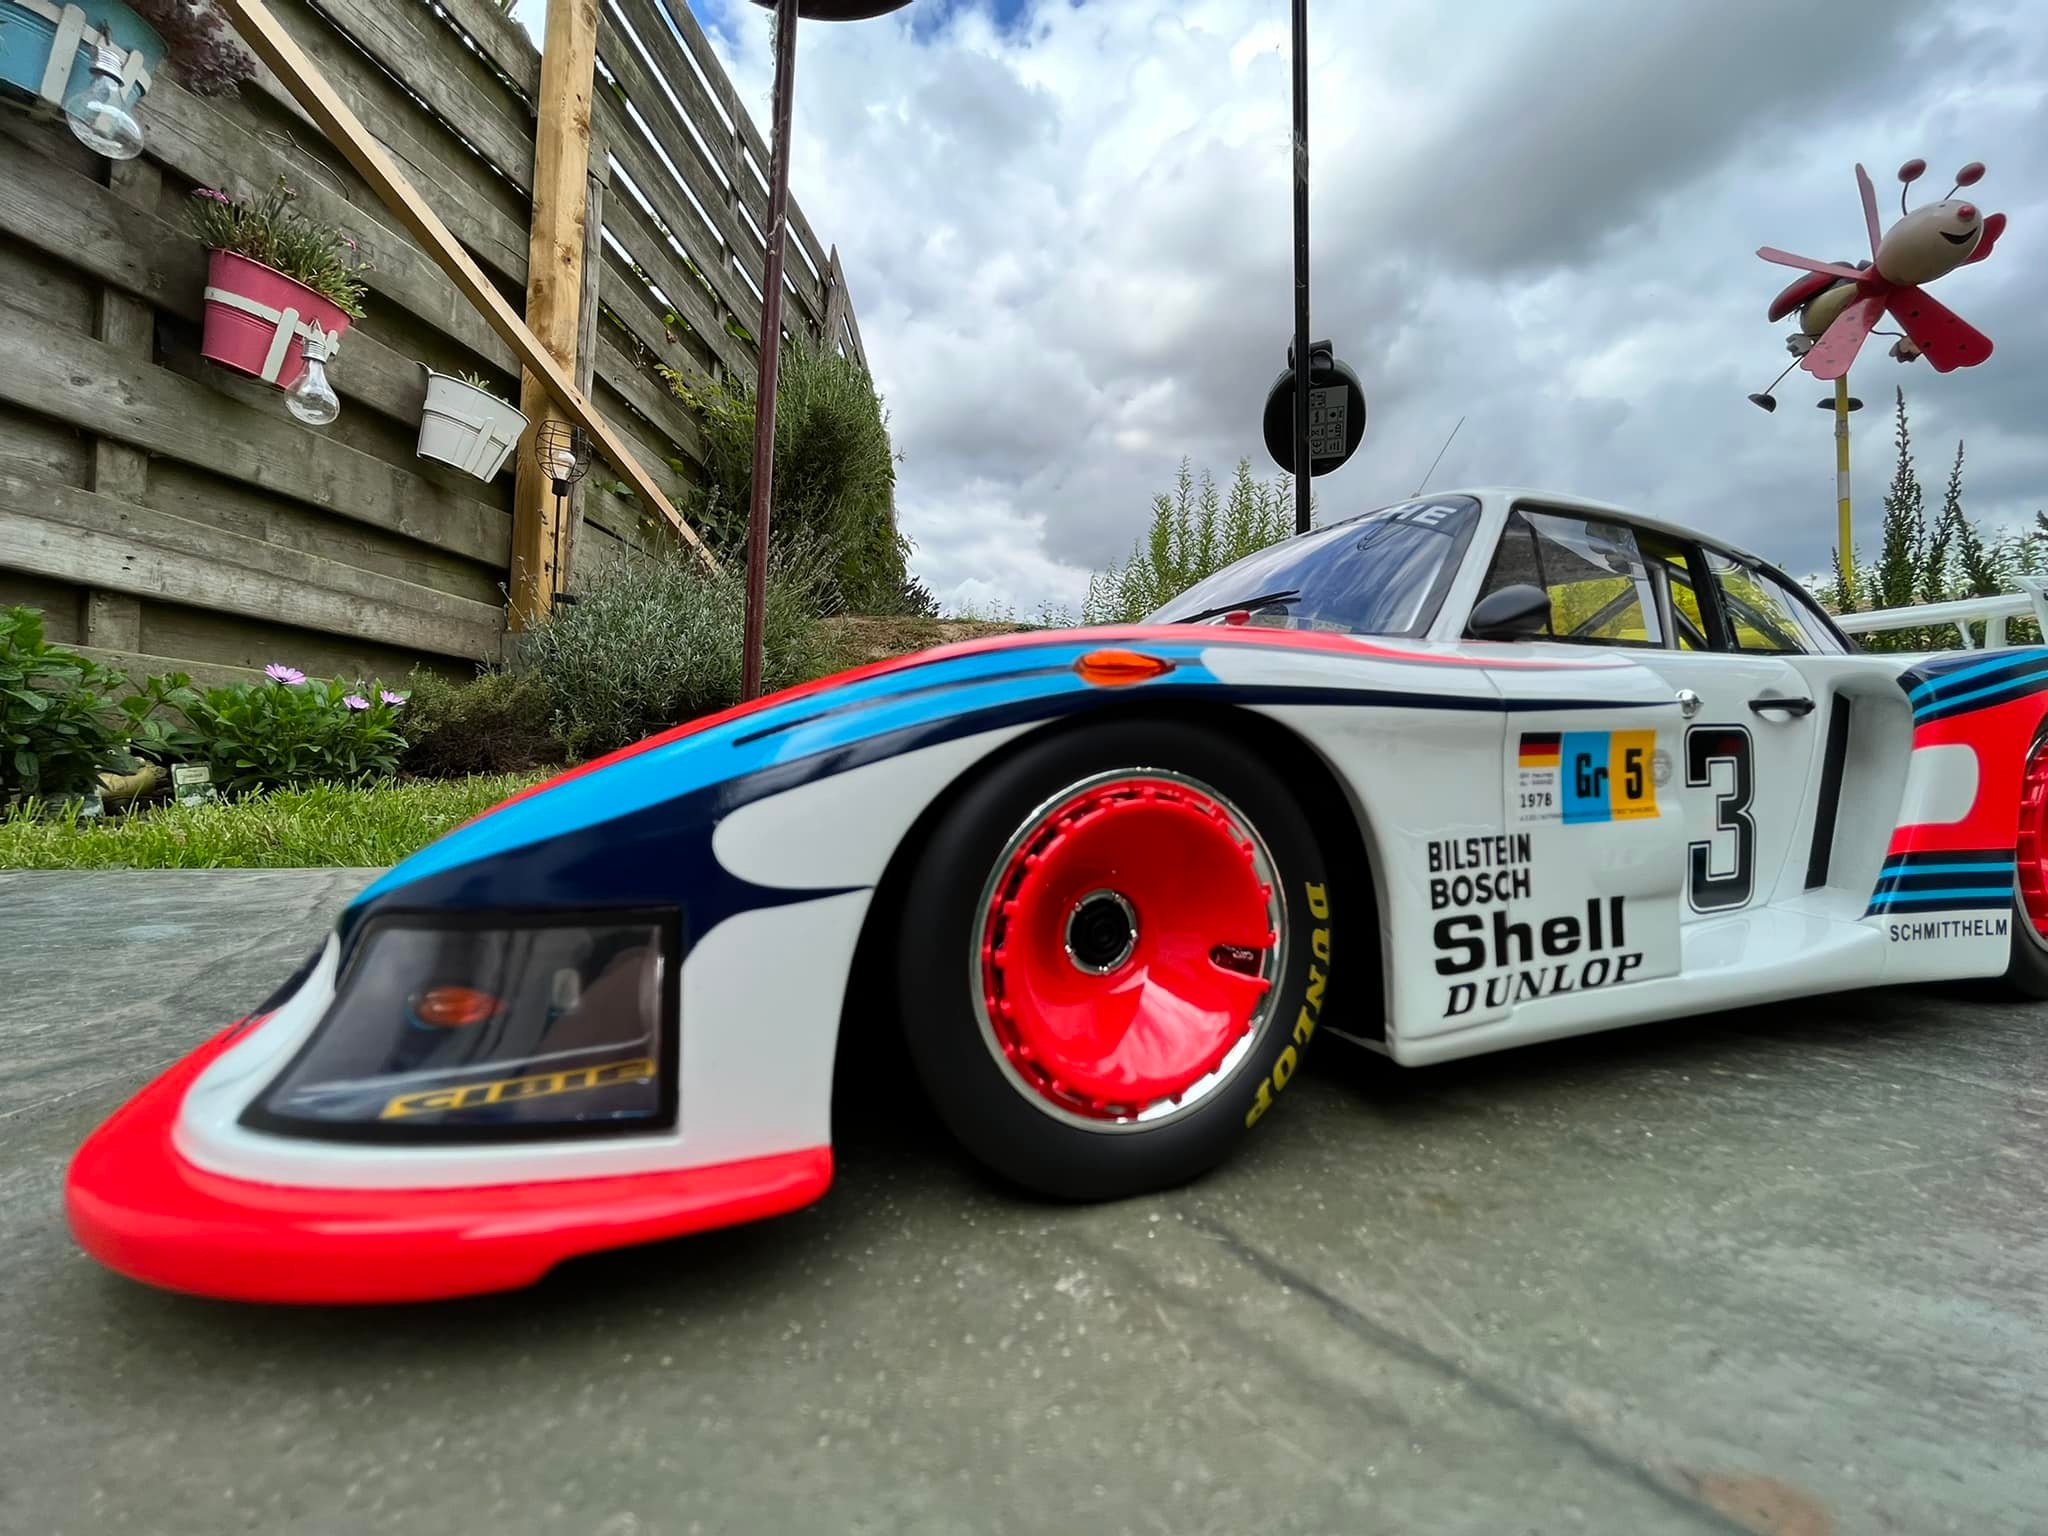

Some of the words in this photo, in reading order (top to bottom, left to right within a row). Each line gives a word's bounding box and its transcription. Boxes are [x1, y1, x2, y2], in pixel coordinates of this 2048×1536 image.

[1575, 752, 1608, 798] Gr
[1625, 748, 1643, 800] 5
[1519, 793, 1552, 808] 1978
[1684, 723, 1757, 914] 3
[1428, 833, 1531, 872] BILSTEIN
[1430, 868, 1531, 910] BOSCH
[1433, 896, 1625, 976] Shell
[1890, 919, 2007, 942] SCHMITTHELM
[1245, 881, 1330, 1128] DUNLOP
[1443, 953, 1643, 1018] DUNLOP
